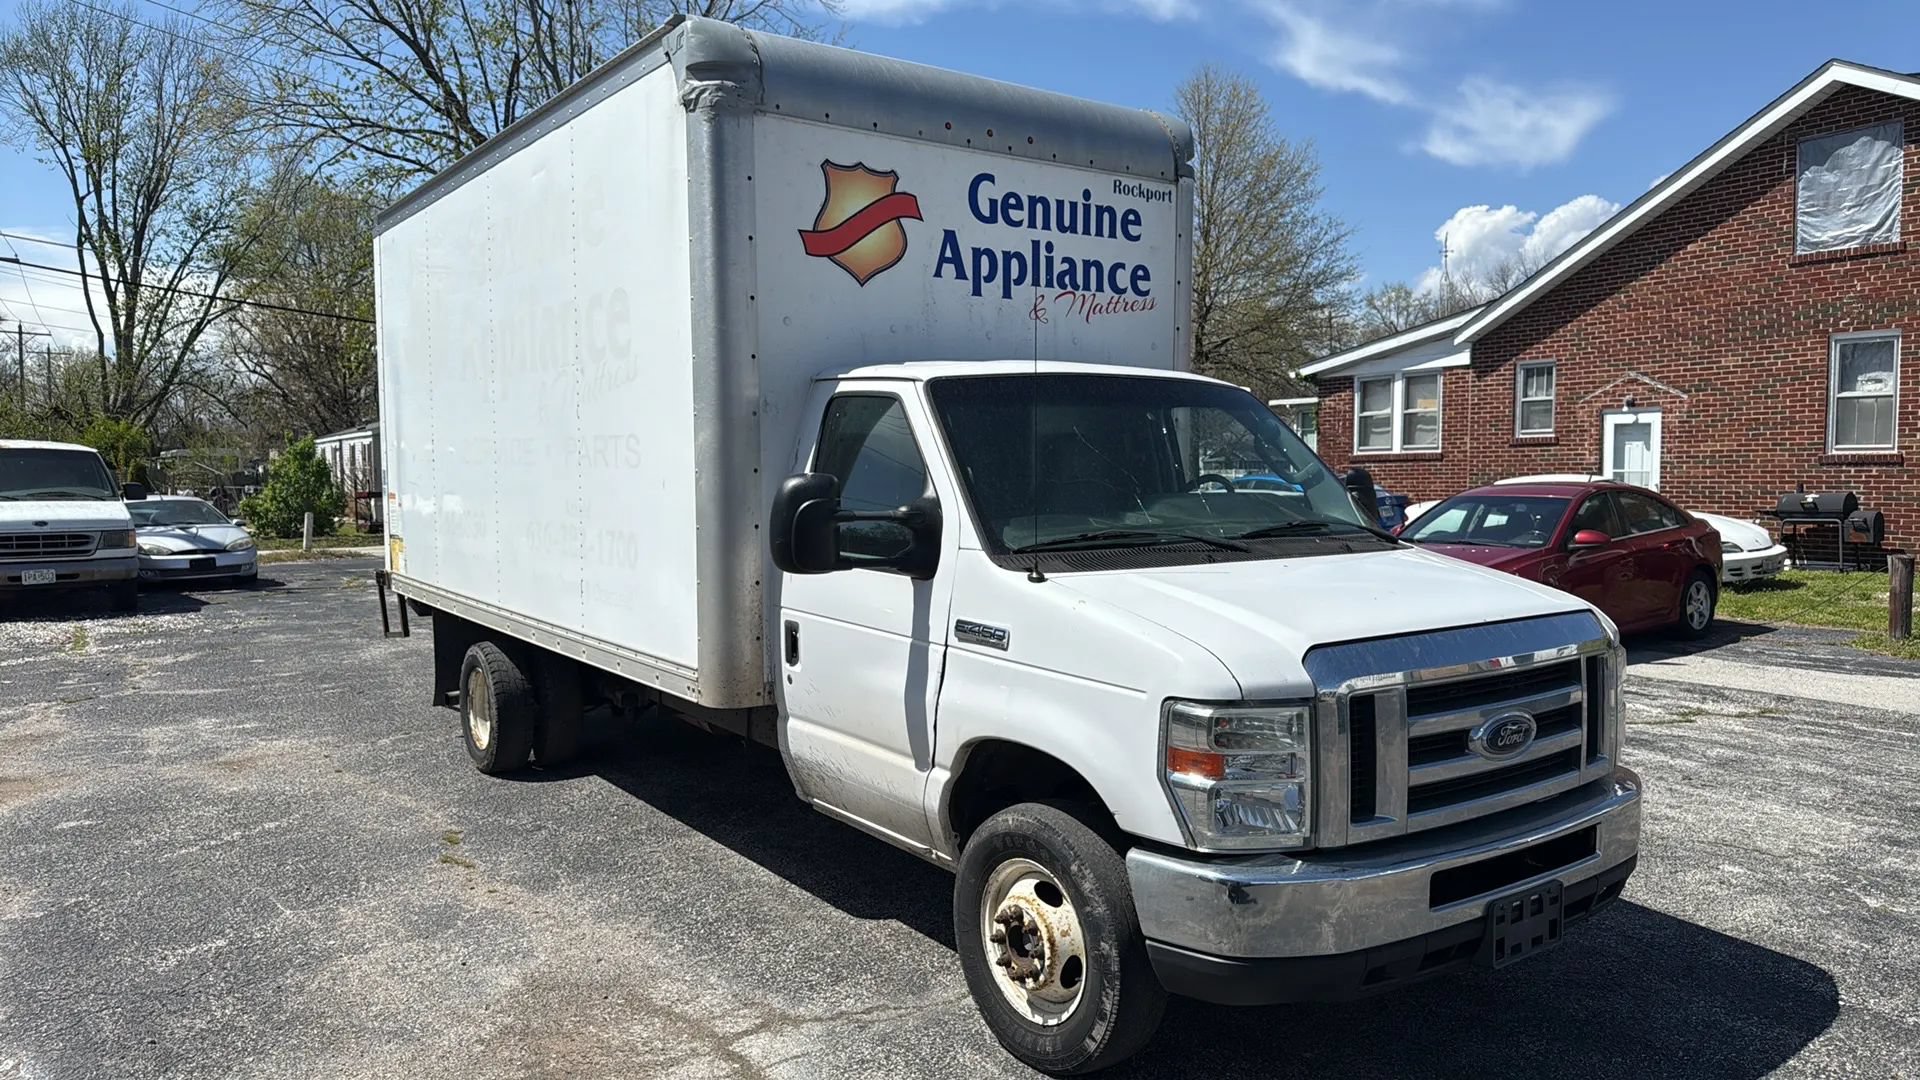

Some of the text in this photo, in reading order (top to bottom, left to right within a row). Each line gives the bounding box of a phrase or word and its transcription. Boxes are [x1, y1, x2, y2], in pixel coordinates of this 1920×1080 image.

[967, 172, 1143, 243] Genuine
[1113, 179, 1173, 204] Rockport
[933, 228, 1152, 299] Appliance
[1028, 289, 1158, 324] & Mattress
[565, 432, 642, 470] PARTS
[1497, 722, 1529, 746] Ford
